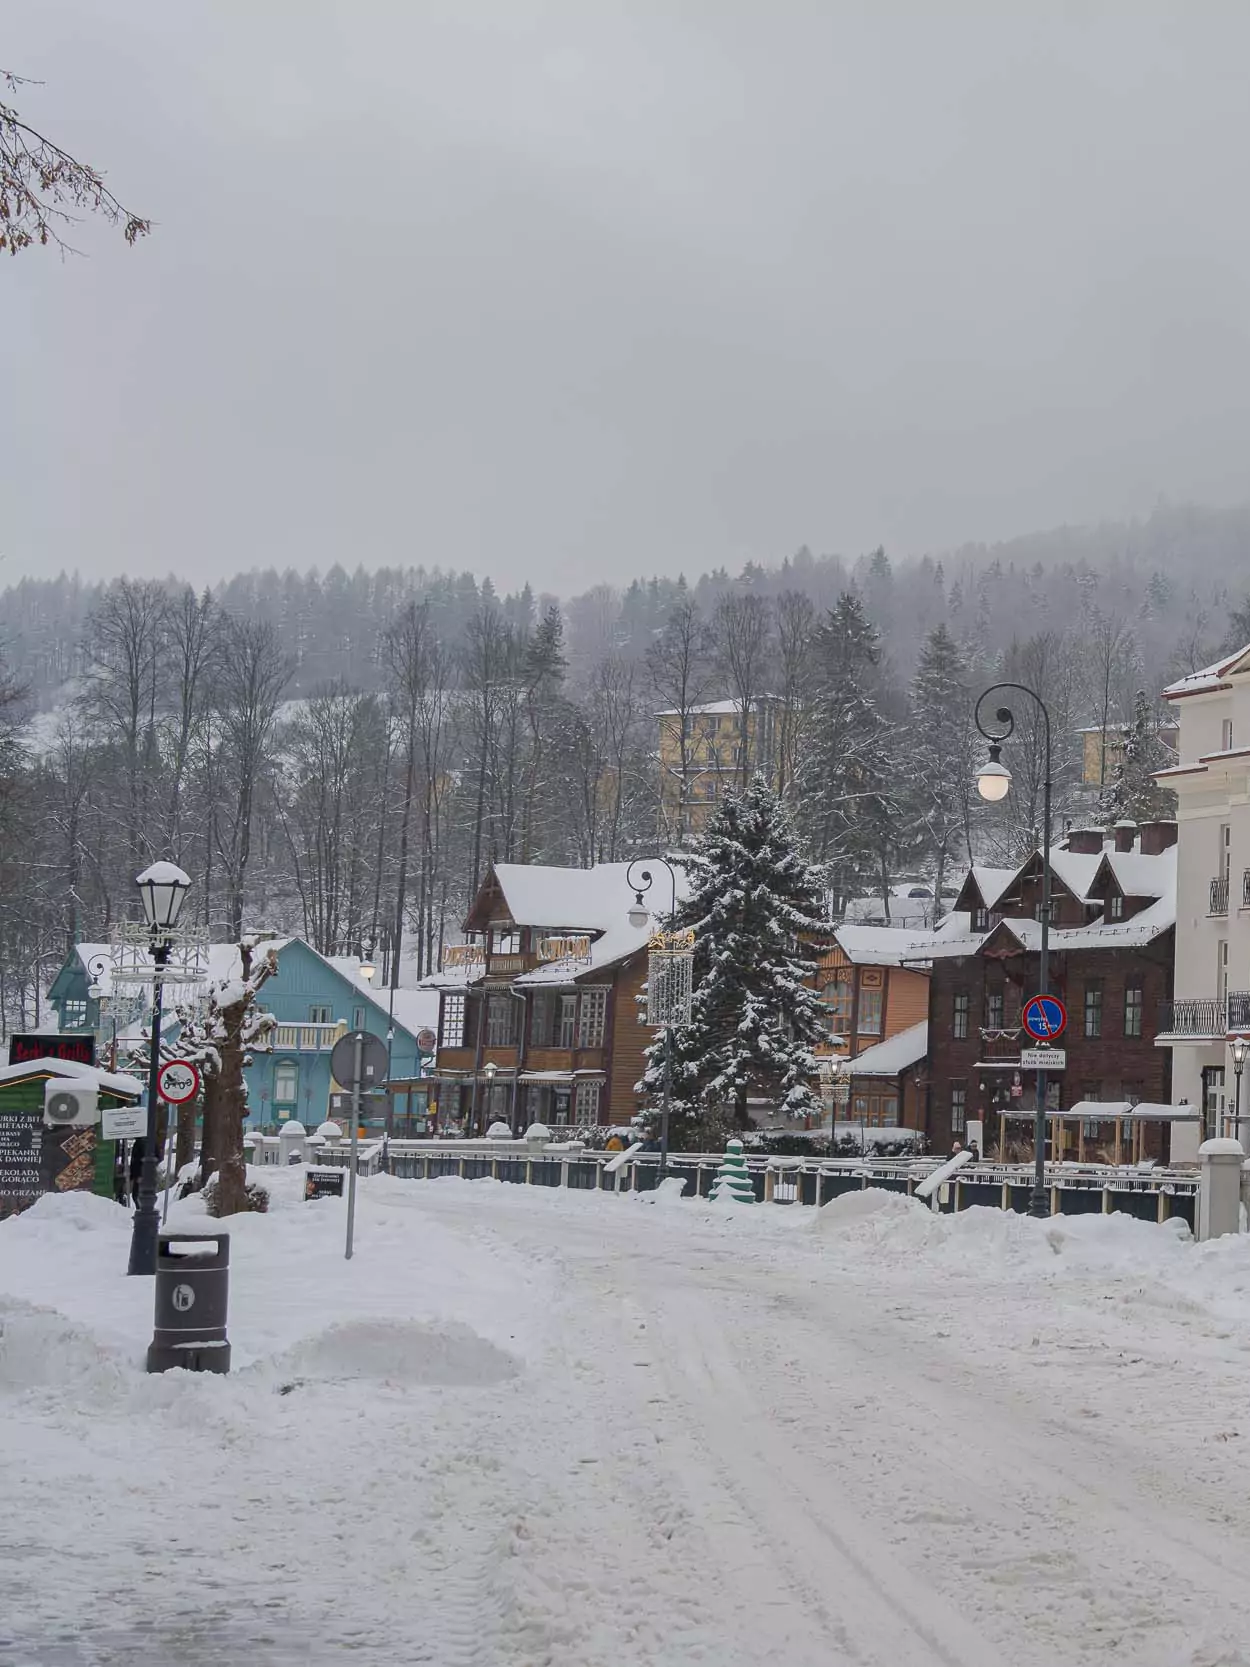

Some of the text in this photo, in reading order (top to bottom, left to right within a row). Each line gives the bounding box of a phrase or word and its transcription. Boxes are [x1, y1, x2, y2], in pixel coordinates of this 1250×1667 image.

[1039, 1052, 1060, 1060] dotyczy
[5, 1156, 42, 1164] DAWNIEJ
[1, 1176, 40, 1184] GORĄCO
